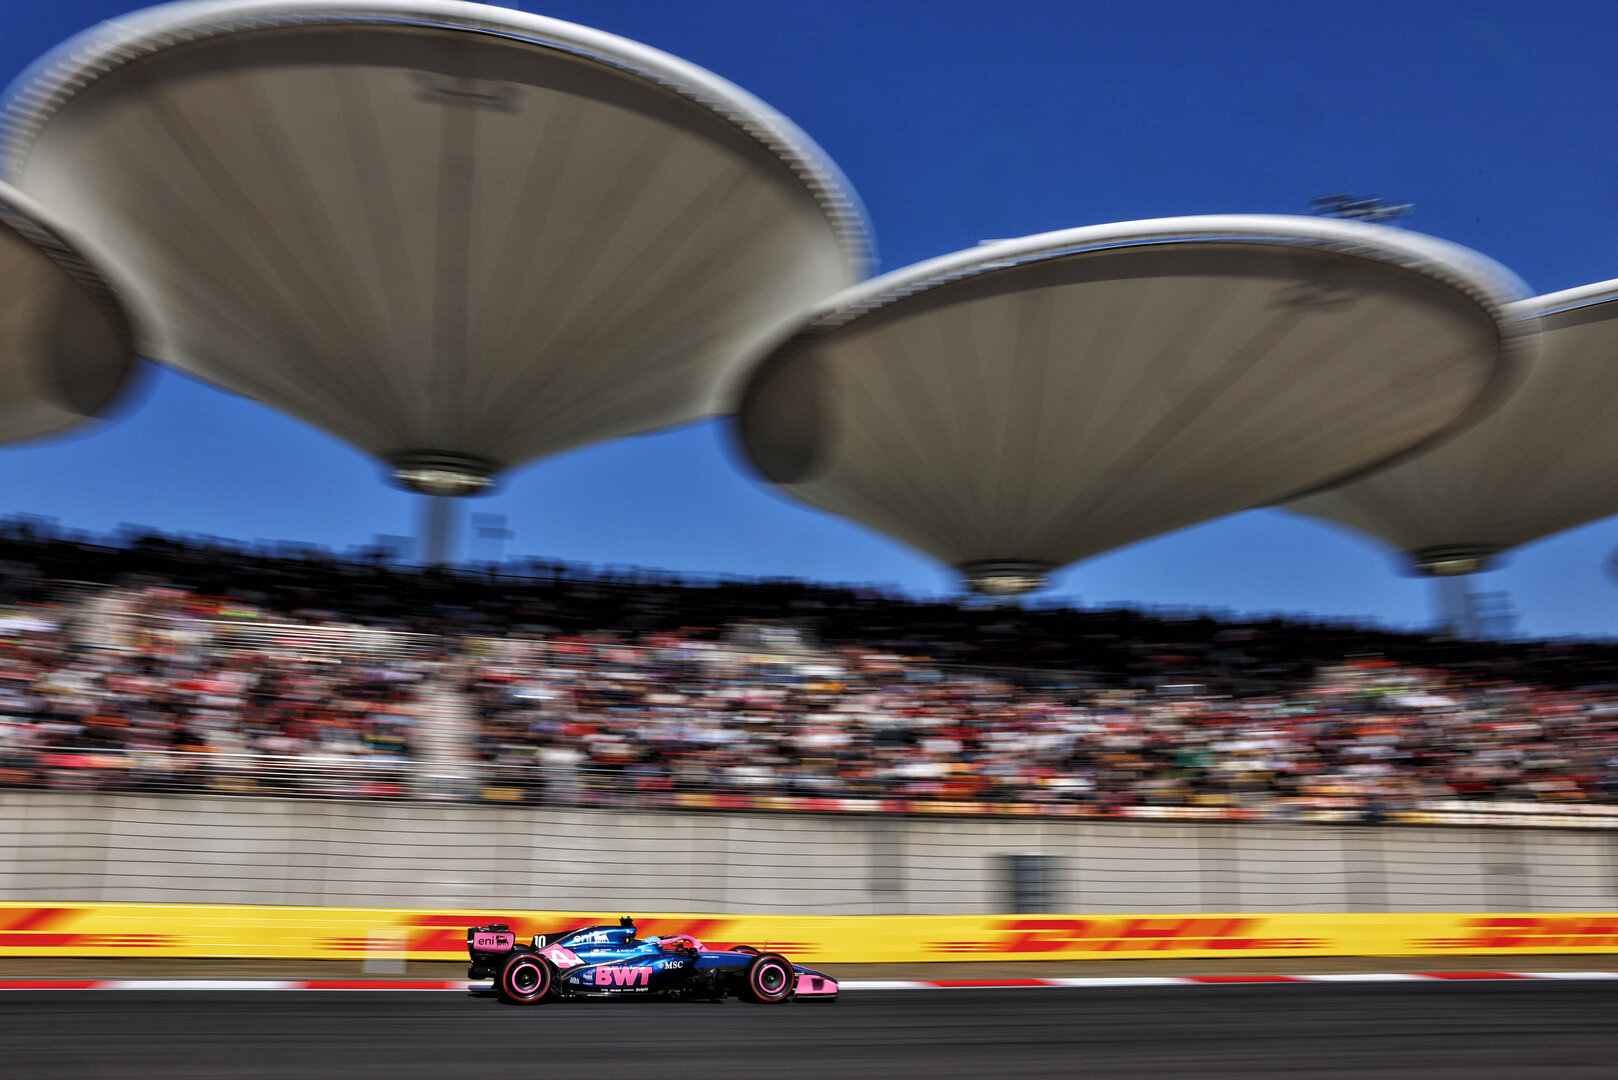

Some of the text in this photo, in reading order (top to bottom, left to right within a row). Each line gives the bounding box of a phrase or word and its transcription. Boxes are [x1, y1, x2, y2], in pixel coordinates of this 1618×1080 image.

[478, 936, 494, 945] eni
[573, 932, 592, 943] eni
[985, 918, 1270, 952] DHL
[534, 935, 546, 949] 10
[664, 961, 684, 970] MSC
[595, 965, 653, 986] BWT
